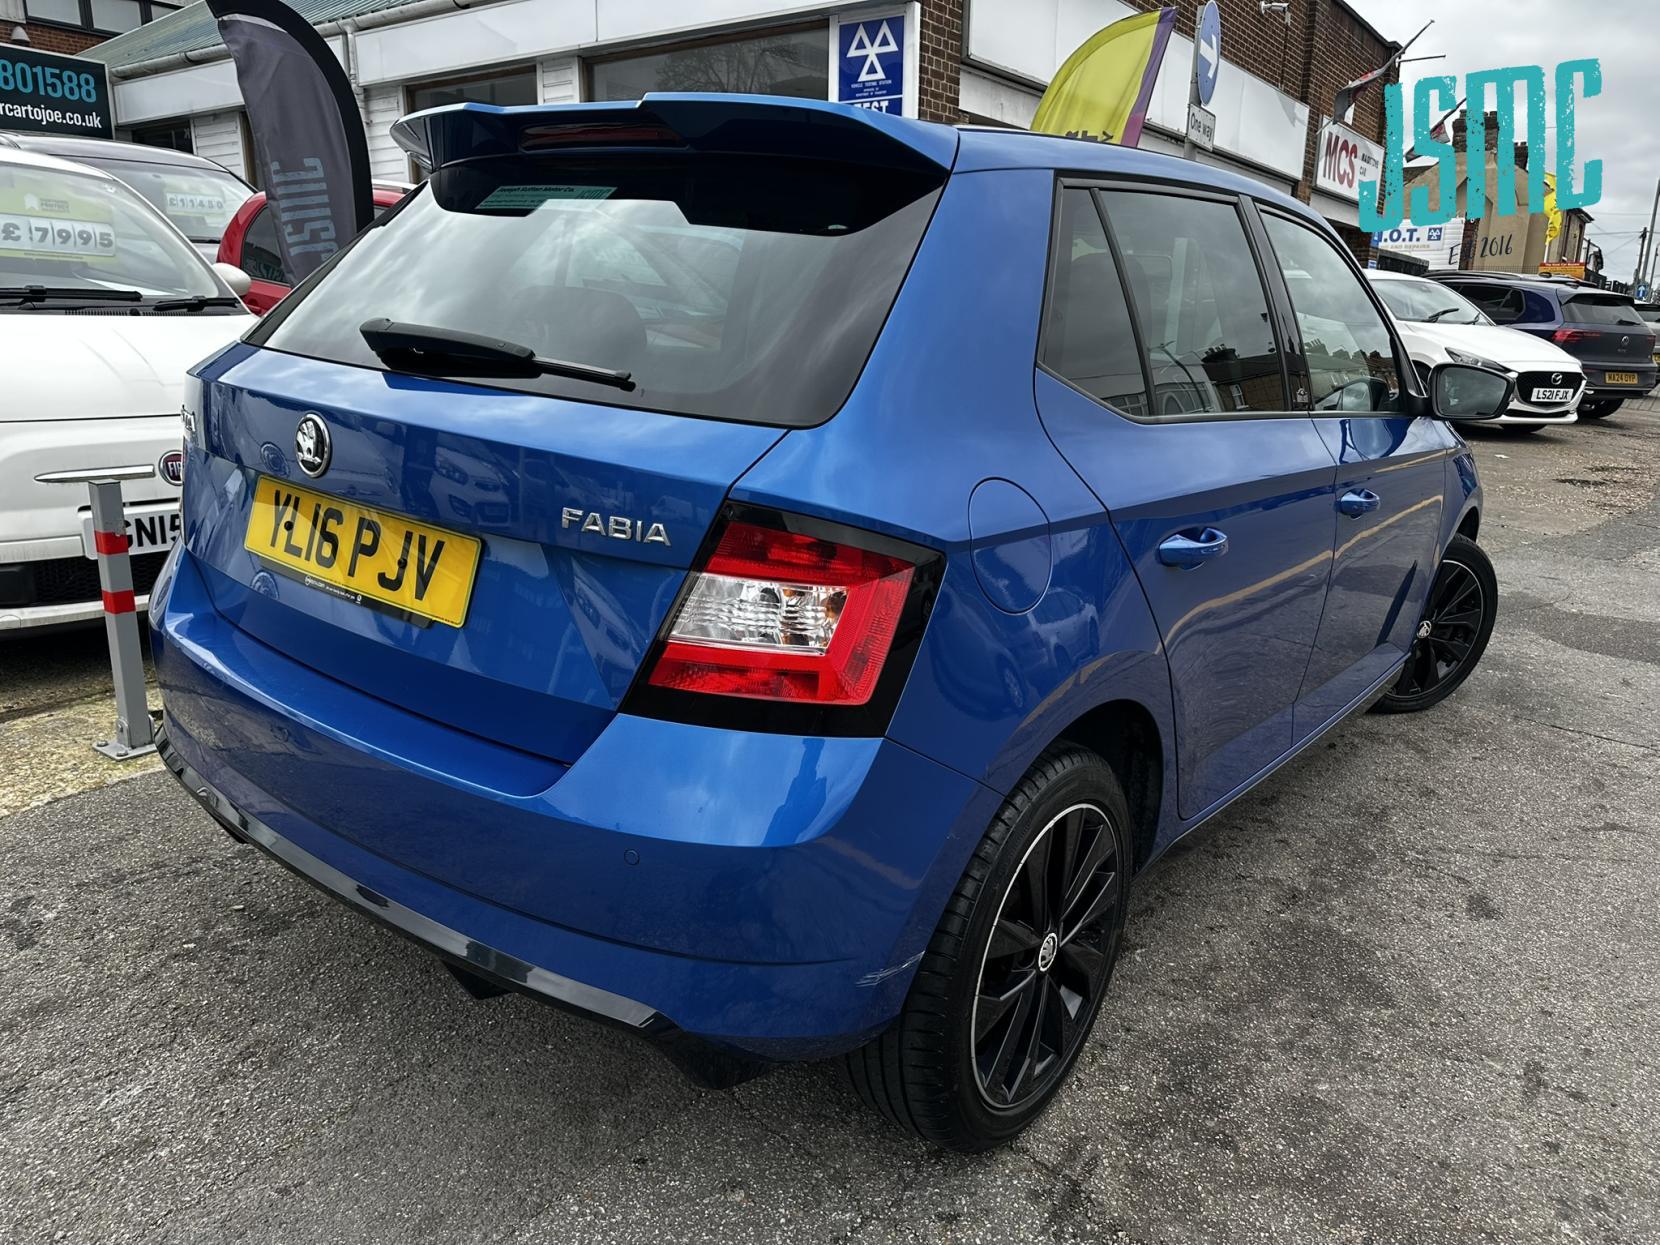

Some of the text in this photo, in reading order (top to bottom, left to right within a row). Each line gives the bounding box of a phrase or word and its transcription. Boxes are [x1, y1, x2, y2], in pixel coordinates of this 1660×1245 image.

[0, 59, 97, 103] 801588
[1190, 112, 1213, 142] One way
[1323, 131, 1358, 189] MCS
[1, 222, 114, 249] £7995
[1480, 233, 1513, 257] 2016
[1536, 390, 1570, 400] LS21 FJX
[561, 507, 671, 546] FABIA
[270, 489, 445, 601] YL16 PJV
